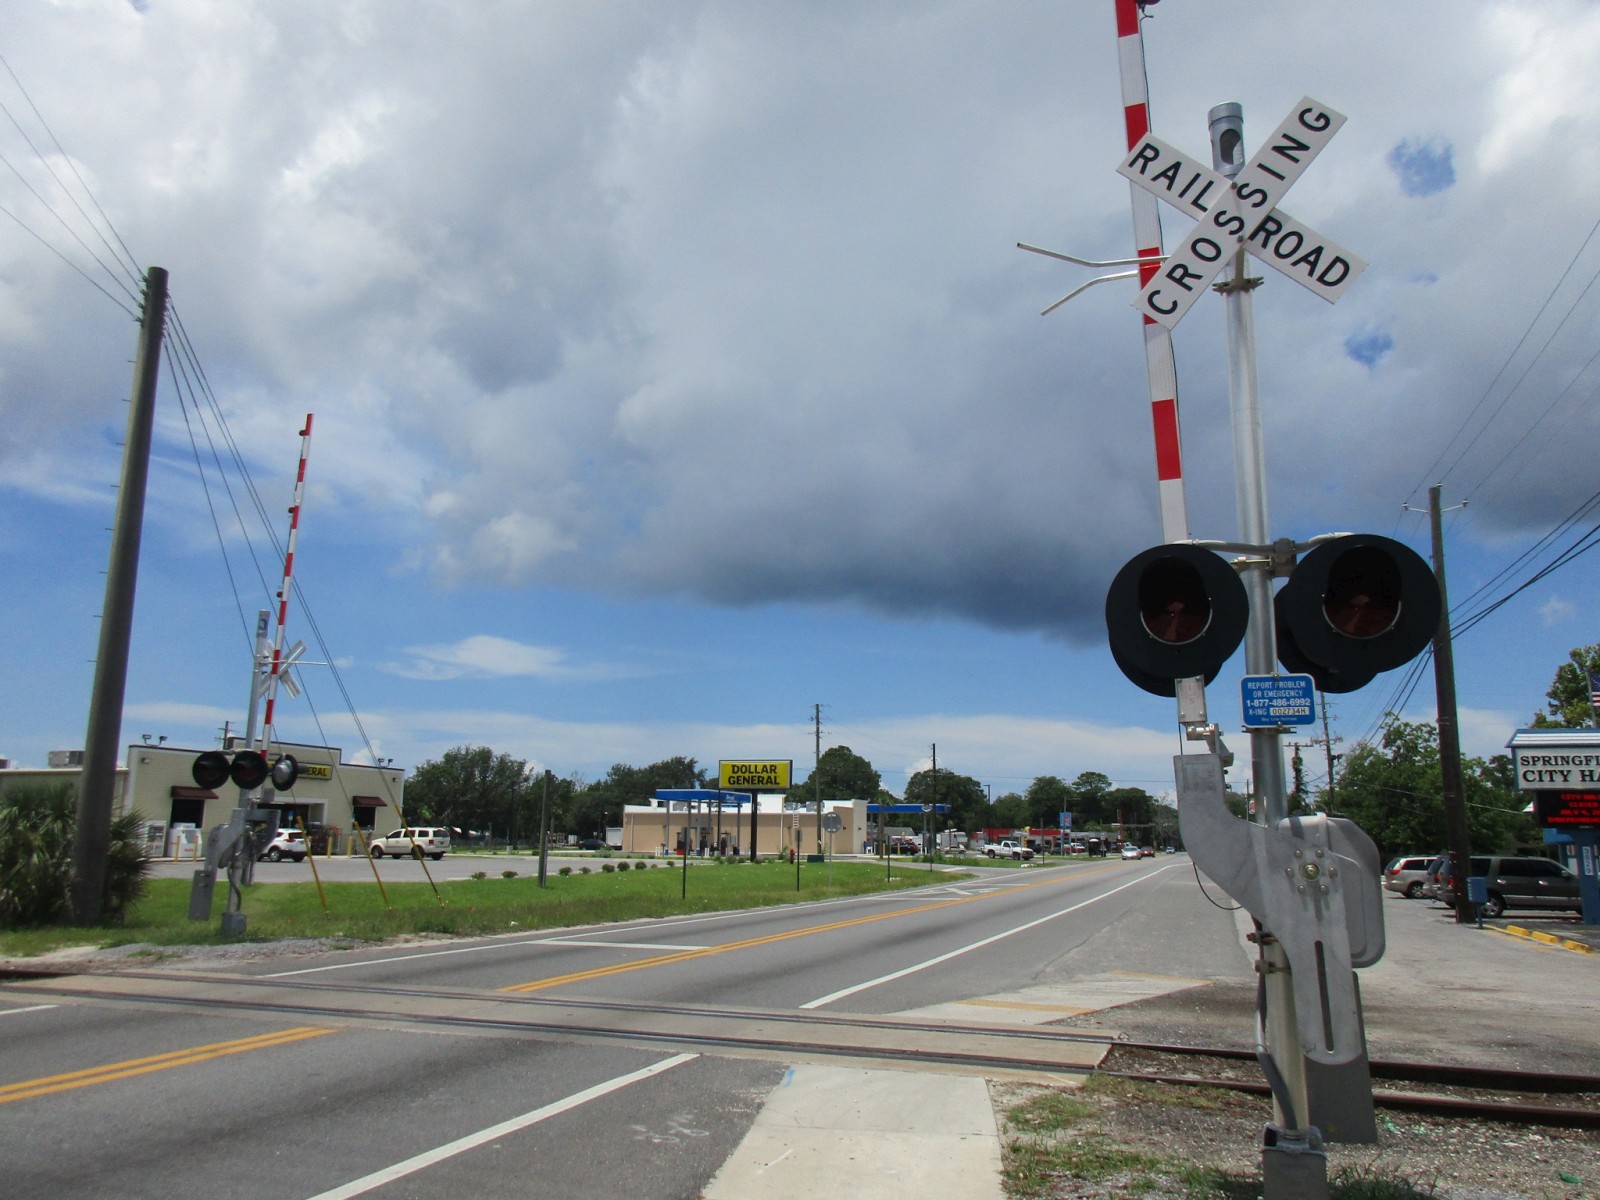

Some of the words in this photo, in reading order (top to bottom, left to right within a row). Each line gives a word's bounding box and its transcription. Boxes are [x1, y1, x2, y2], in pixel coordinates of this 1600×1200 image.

[1128, 143, 1215, 213] RAIL
[1247, 215, 1350, 287] ROAD
[1147, 107, 1331, 315] CROSSING
[1247, 698, 1310, 707] 1-877-486-6992
[732, 764, 777, 774] DOLLAR
[728, 775, 780, 785] GENERAL
[1522, 769, 1571, 783] CITY
